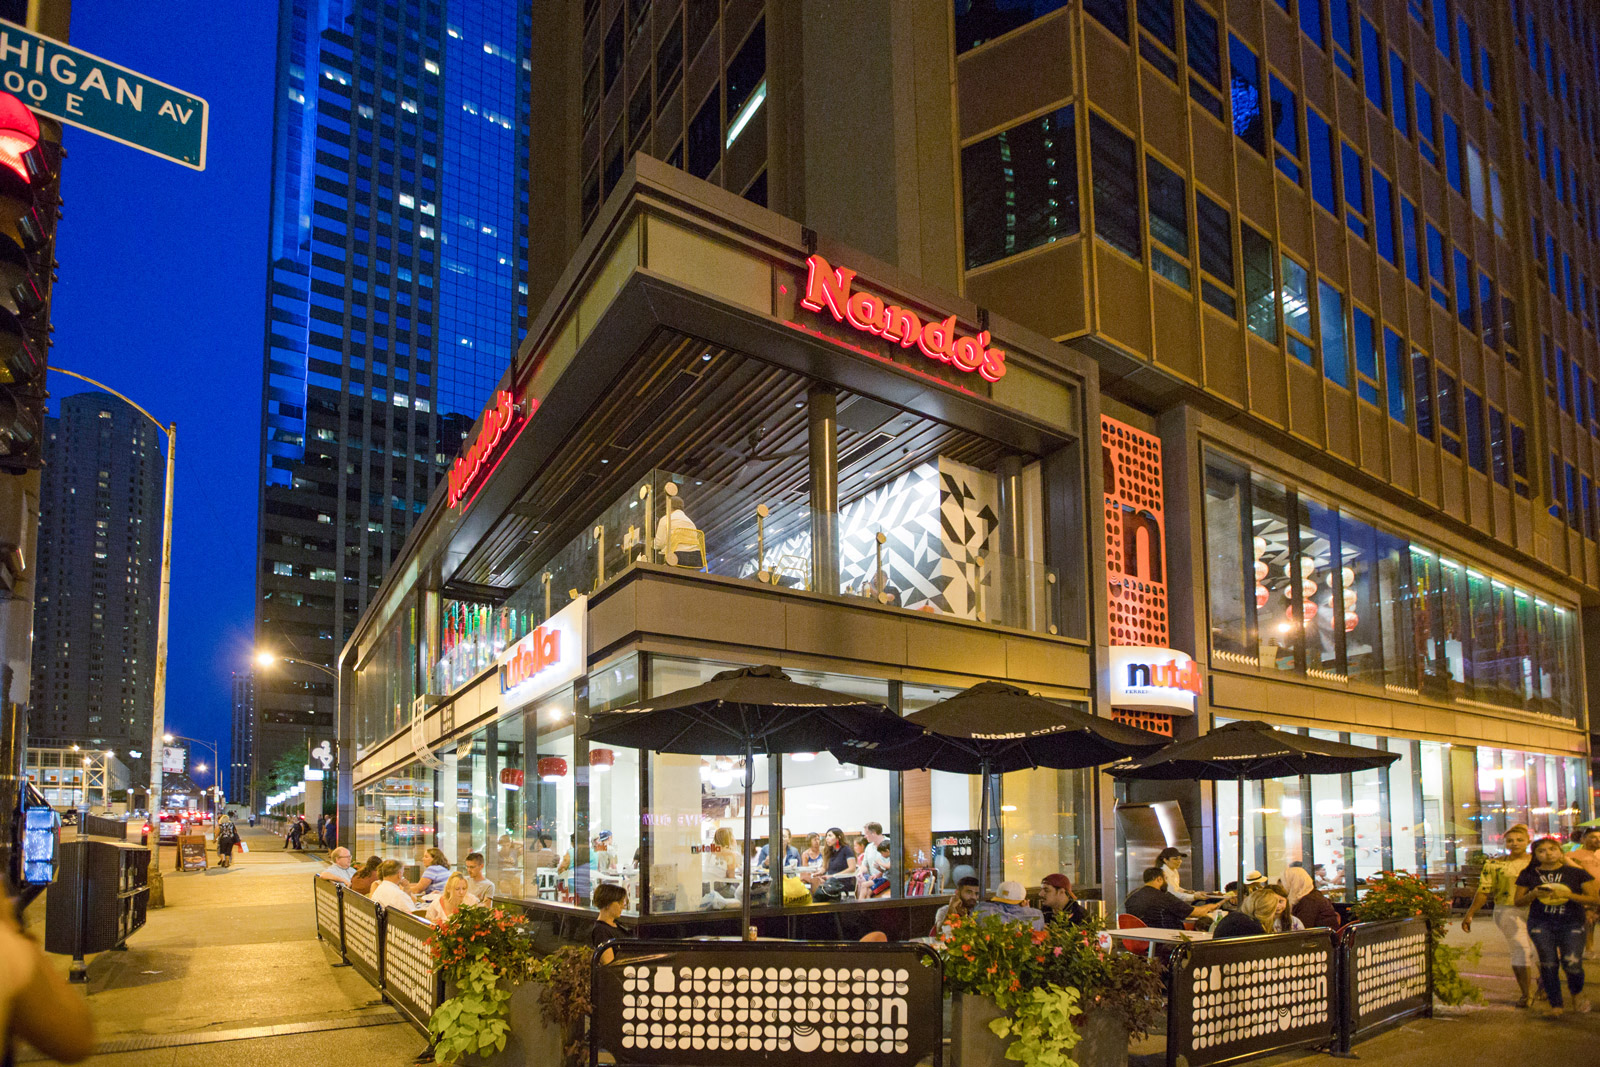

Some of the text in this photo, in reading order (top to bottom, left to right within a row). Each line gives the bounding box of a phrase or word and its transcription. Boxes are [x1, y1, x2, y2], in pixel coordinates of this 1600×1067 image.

[66, 92, 84, 117] E
[158, 100, 194, 125] AV
[800, 254, 1007, 383] Nando's
[499, 626, 561, 694] nutella
[971, 732, 1026, 740] nutella
[691, 844, 721, 854] nutella
[881, 997, 908, 1025] n
